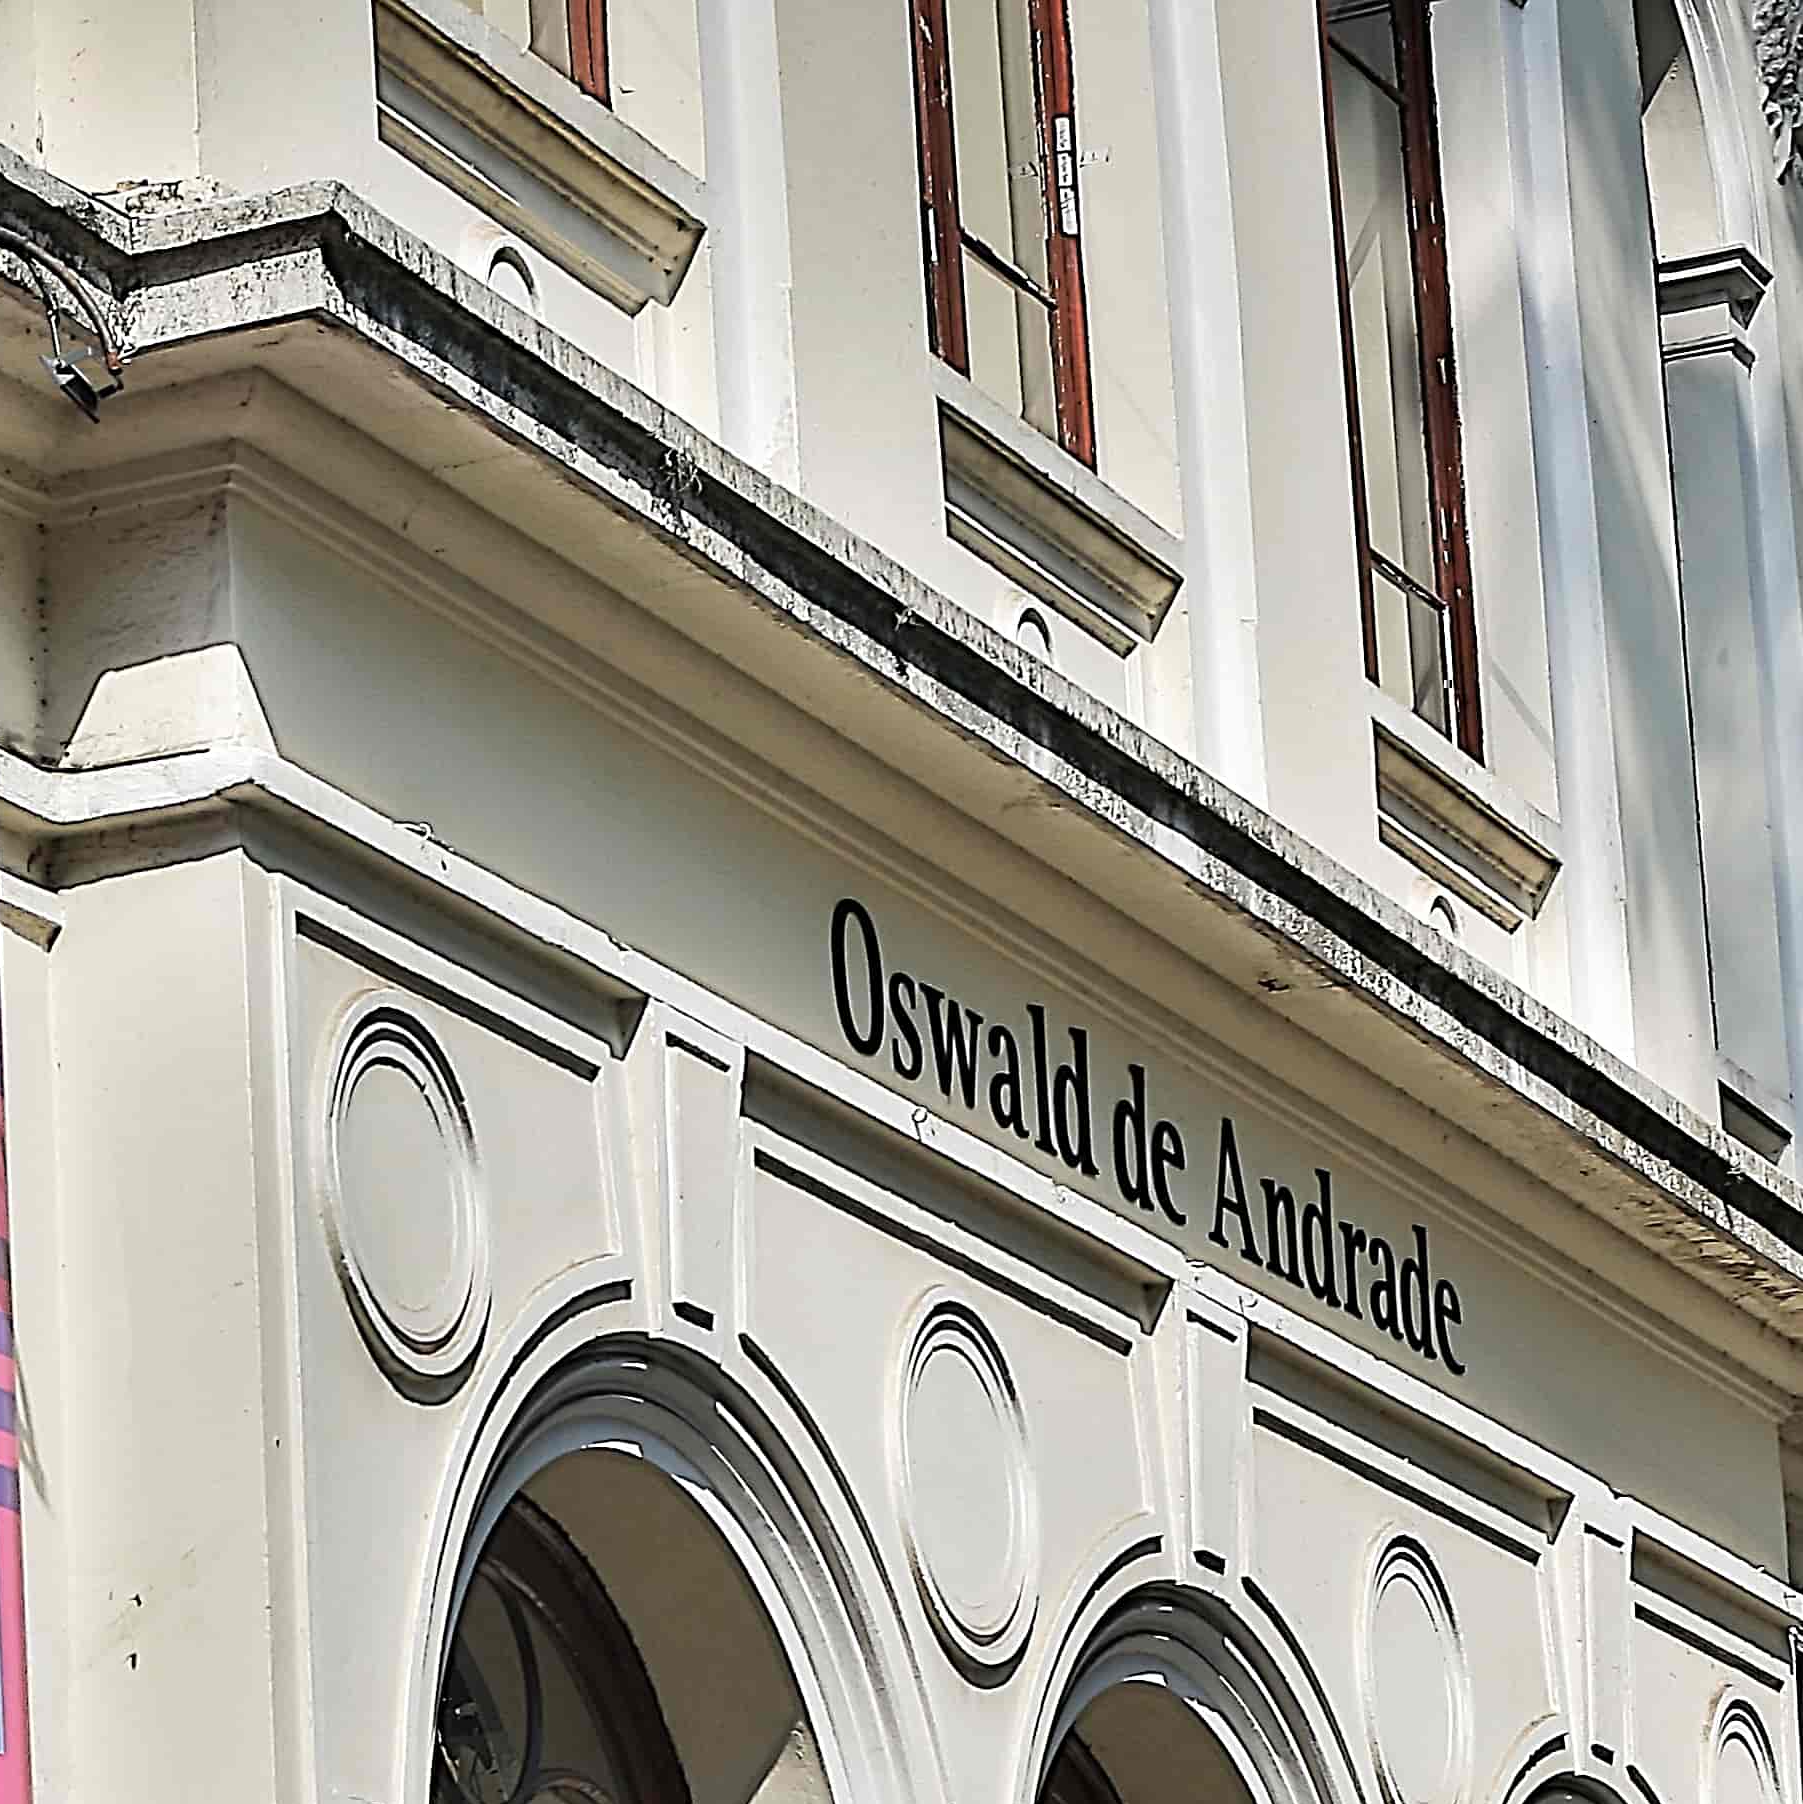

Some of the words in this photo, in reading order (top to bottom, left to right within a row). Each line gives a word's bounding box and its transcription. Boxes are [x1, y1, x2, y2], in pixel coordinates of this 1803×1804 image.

[830, 898, 1100, 1176] Oswald
[1113, 1064, 1187, 1226] de
[1208, 1117, 1466, 1376] Andrade
